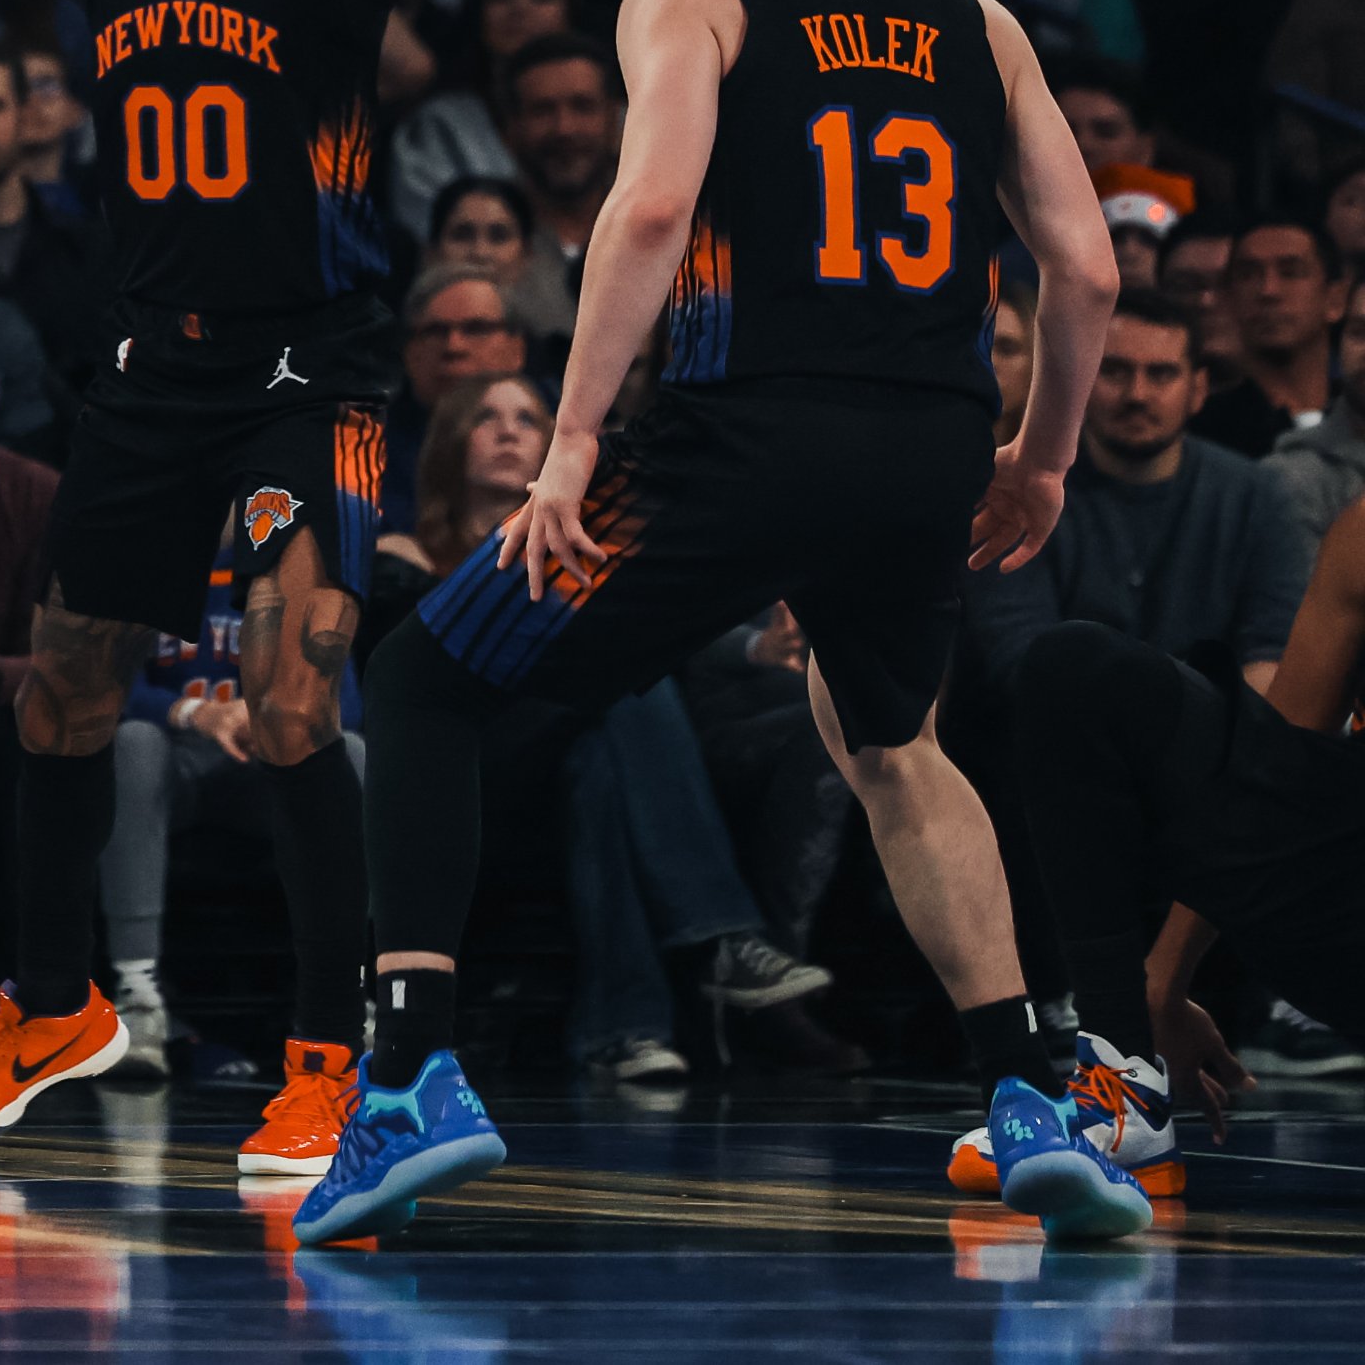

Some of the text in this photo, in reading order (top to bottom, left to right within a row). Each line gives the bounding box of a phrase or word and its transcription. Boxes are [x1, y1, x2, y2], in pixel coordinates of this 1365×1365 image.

[95, 0, 282, 81] NEW YORK
[799, 12, 940, 84] KOLEK
[122, 82, 250, 204] 00
[806, 104, 959, 295] 13
